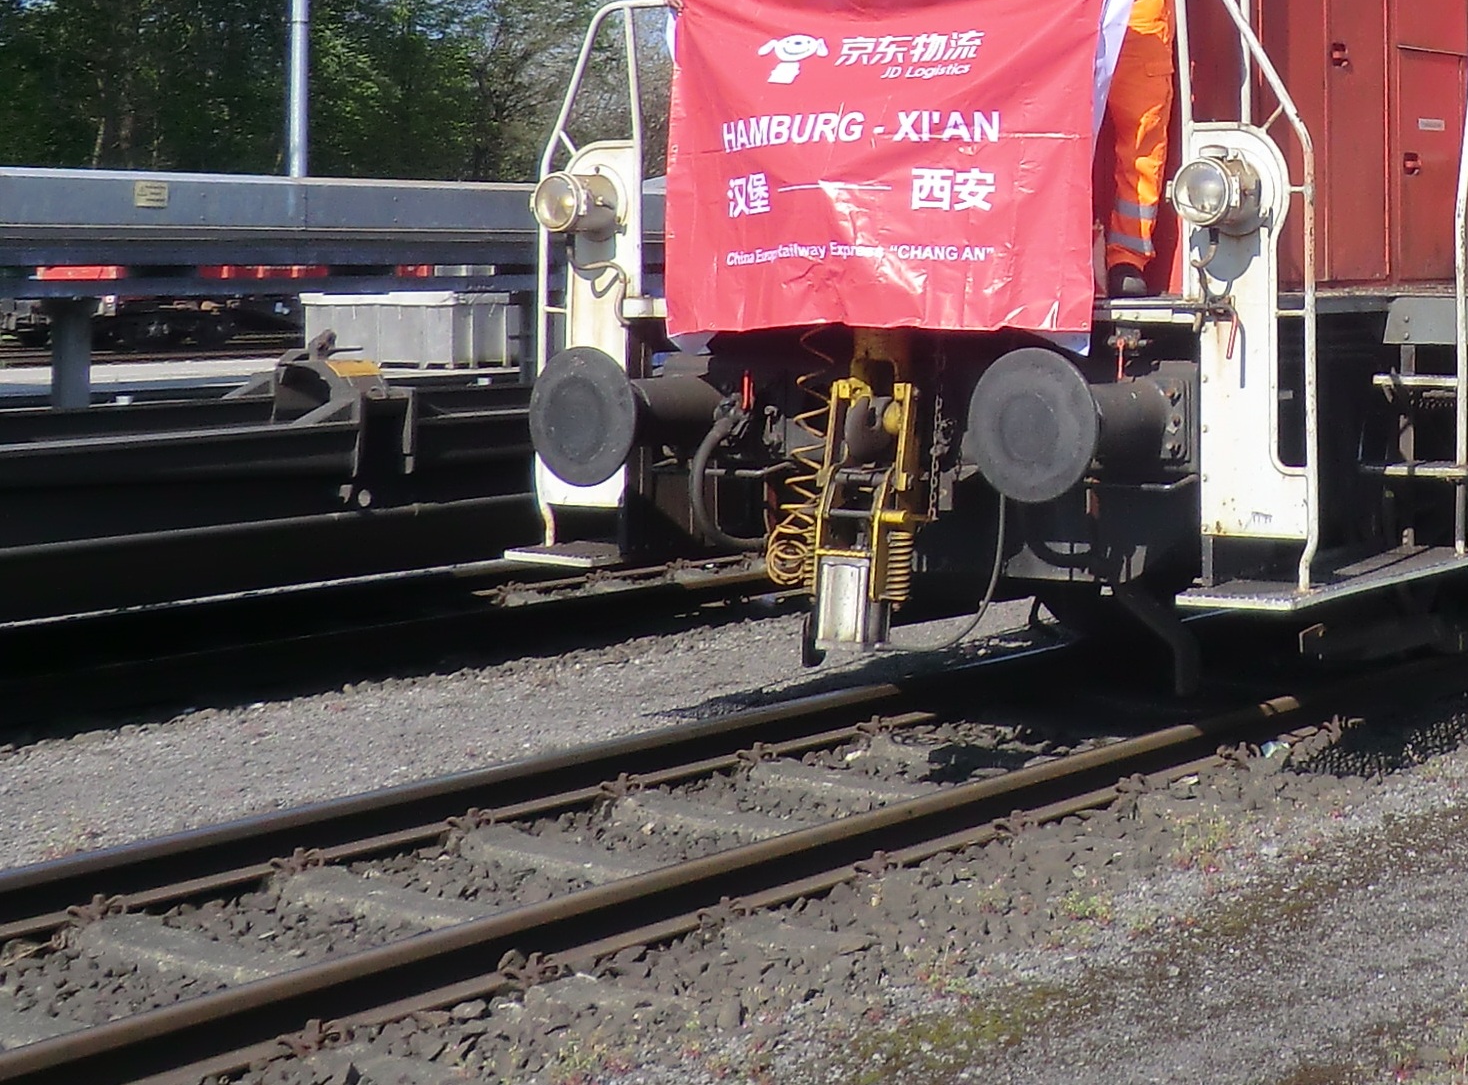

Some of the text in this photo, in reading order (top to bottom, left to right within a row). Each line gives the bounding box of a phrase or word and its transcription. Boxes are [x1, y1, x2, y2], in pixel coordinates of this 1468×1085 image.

[834, 29, 985, 66] 京东物流
[880, 63, 971, 80] JD Logistics
[722, 112, 865, 153] HAMBURG
[892, 110, 1000, 143] XI'AN
[727, 172, 771, 218] 汉堡
[911, 167, 996, 212] 西安
[726, 251, 755, 266] China
